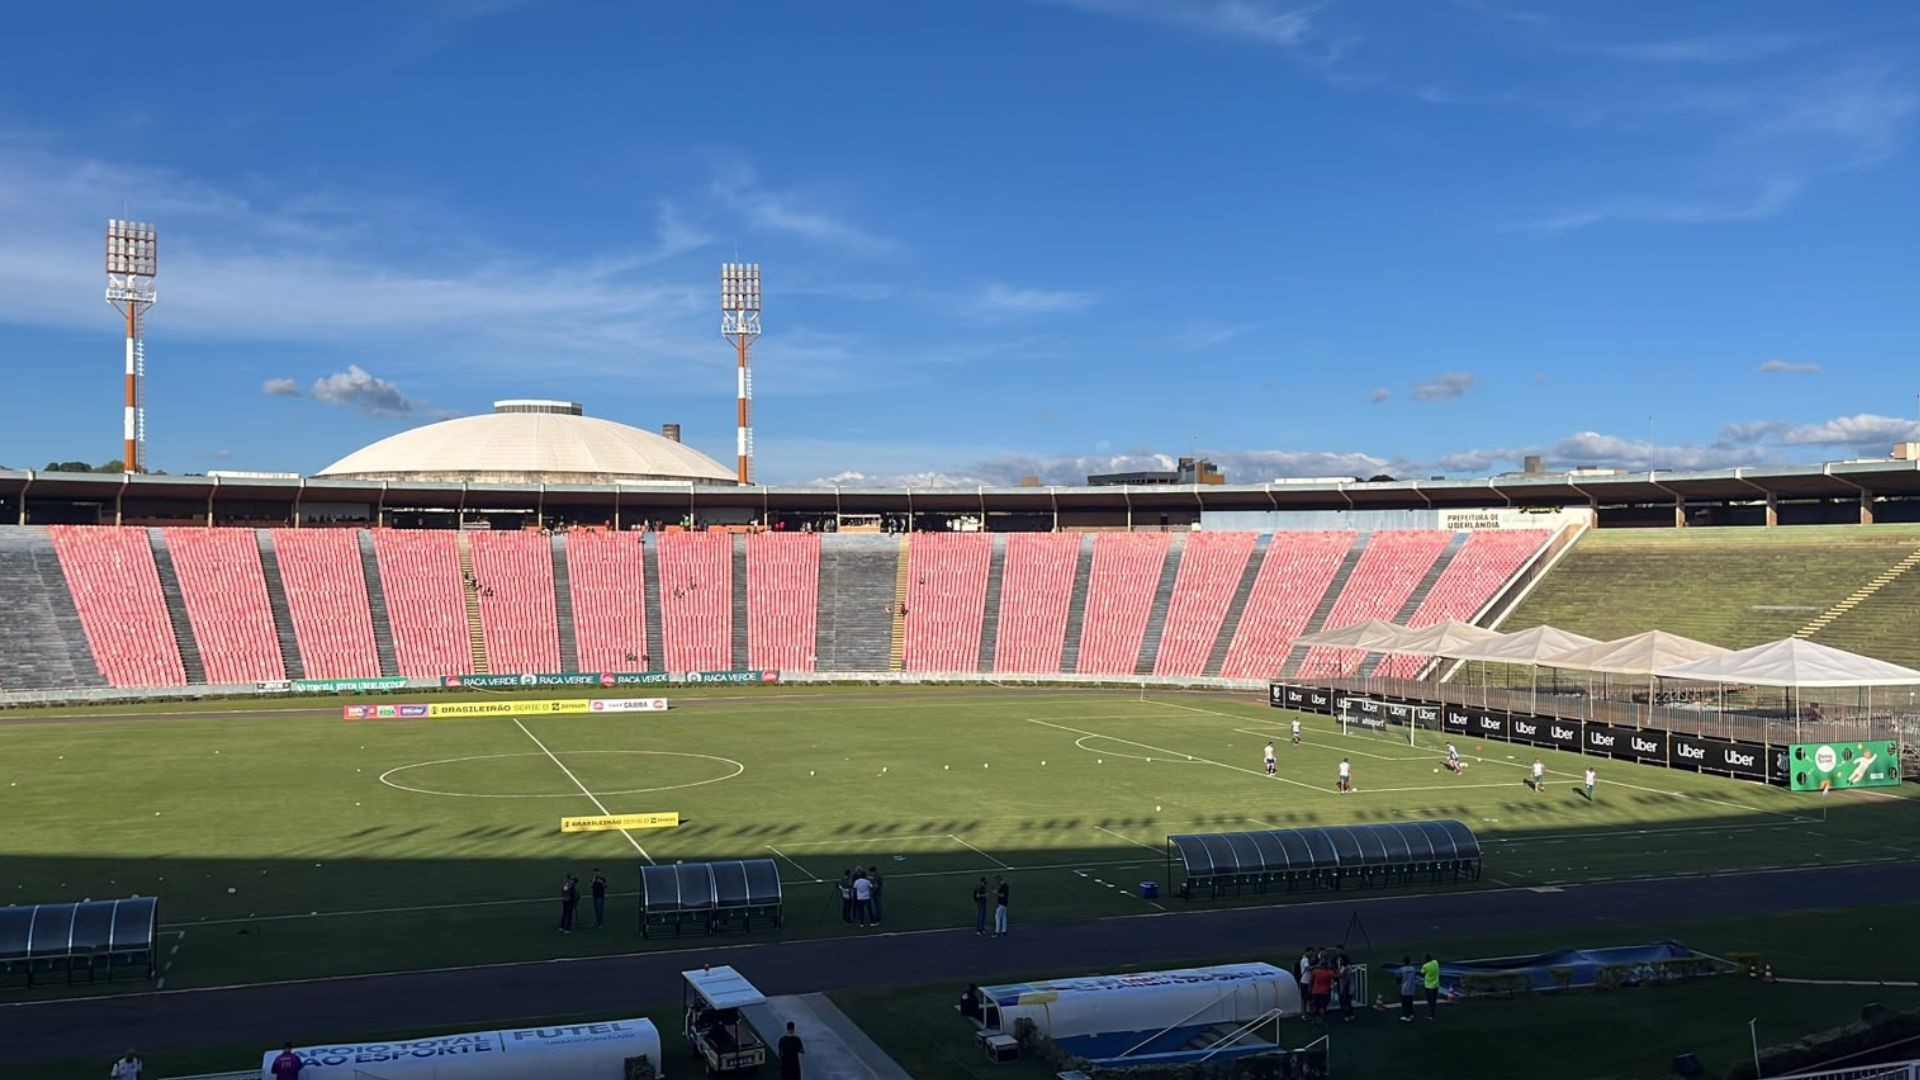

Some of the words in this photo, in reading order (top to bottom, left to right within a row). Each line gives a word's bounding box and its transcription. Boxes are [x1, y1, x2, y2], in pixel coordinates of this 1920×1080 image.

[487, 677, 518, 685] VERDE
[562, 676, 593, 684] VERDE
[641, 675, 669, 683] VERDE
[728, 673, 756, 681] VERDE
[1288, 692, 1302, 702] Uber
[1312, 694, 1326, 704] Uber
[1362, 701, 1378, 712] Uber
[1390, 705, 1406, 716] Uber
[1418, 708, 1436, 720] Uber
[1449, 713, 1468, 726] Uber
[1480, 716, 1500, 730] Uber
[1516, 722, 1536, 735] Uber
[1551, 726, 1574, 740] Uber
[1591, 732, 1614, 747] Uber
[1632, 737, 1657, 752] Uber
[1678, 743, 1705, 759] Uber
[1725, 750, 1754, 766] Uber
[513, 1023, 633, 1040] FUTEL
[296, 1045, 390, 1058] APOIO
[397, 1035, 487, 1049] TOTAL
[355, 1039, 492, 1064] ESPORTE
